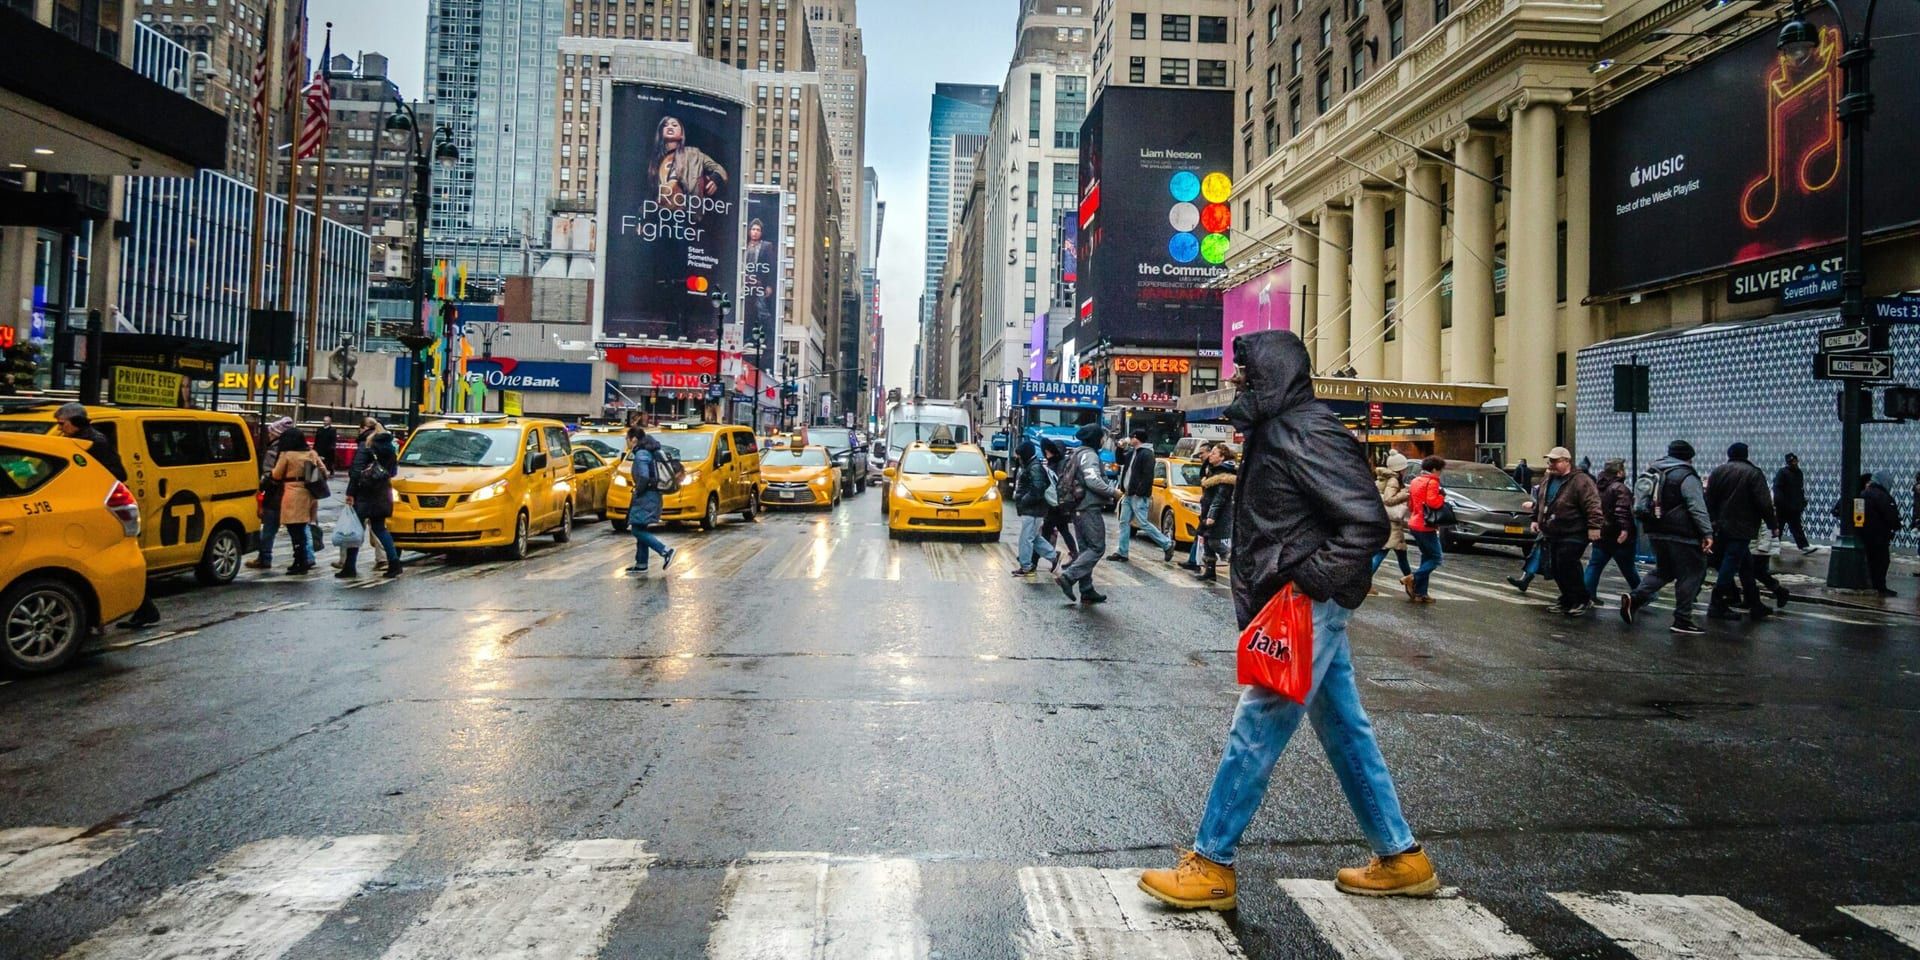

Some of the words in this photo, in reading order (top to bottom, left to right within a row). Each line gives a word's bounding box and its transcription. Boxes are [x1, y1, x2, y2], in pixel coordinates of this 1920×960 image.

[1140, 148, 1164, 158] Liam
[1165, 149, 1202, 160] Neeson
[1641, 154, 1684, 184] MUSIC
[1322, 173, 1353, 200] HOTEL
[657, 184, 733, 215] Rapper
[1616, 202, 1631, 215] Best
[1631, 199, 1640, 210] of
[1640, 196, 1652, 208] the
[1652, 189, 1673, 203] Week
[1673, 179, 1700, 196] Playlist
[642, 200, 696, 225] Poet
[621, 215, 705, 242] Fighter
[687, 246, 705, 254] Start
[687, 254, 719, 264] Something
[1138, 263, 1160, 275] the
[1784, 281, 1818, 300] Seventh
[1820, 280, 1838, 292] Ave
[1877, 303, 1908, 318] West
[1911, 305, 1920, 318] 3
[1828, 336, 1842, 346] ONE
[1847, 334, 1862, 343] WAY
[1114, 359, 1189, 374] HOOTERS
[1837, 362, 1855, 370] ONE
[1862, 363, 1880, 371] WAY
[118, 369, 156, 387] PRIVATE
[157, 375, 176, 388] EYES
[489, 370, 522, 386] One
[522, 376, 561, 388] Bank
[651, 370, 703, 388] Subw
[1022, 381, 1066, 394] FERRARA
[1070, 384, 1101, 395] CORP.
[171, 503, 195, 545] T
